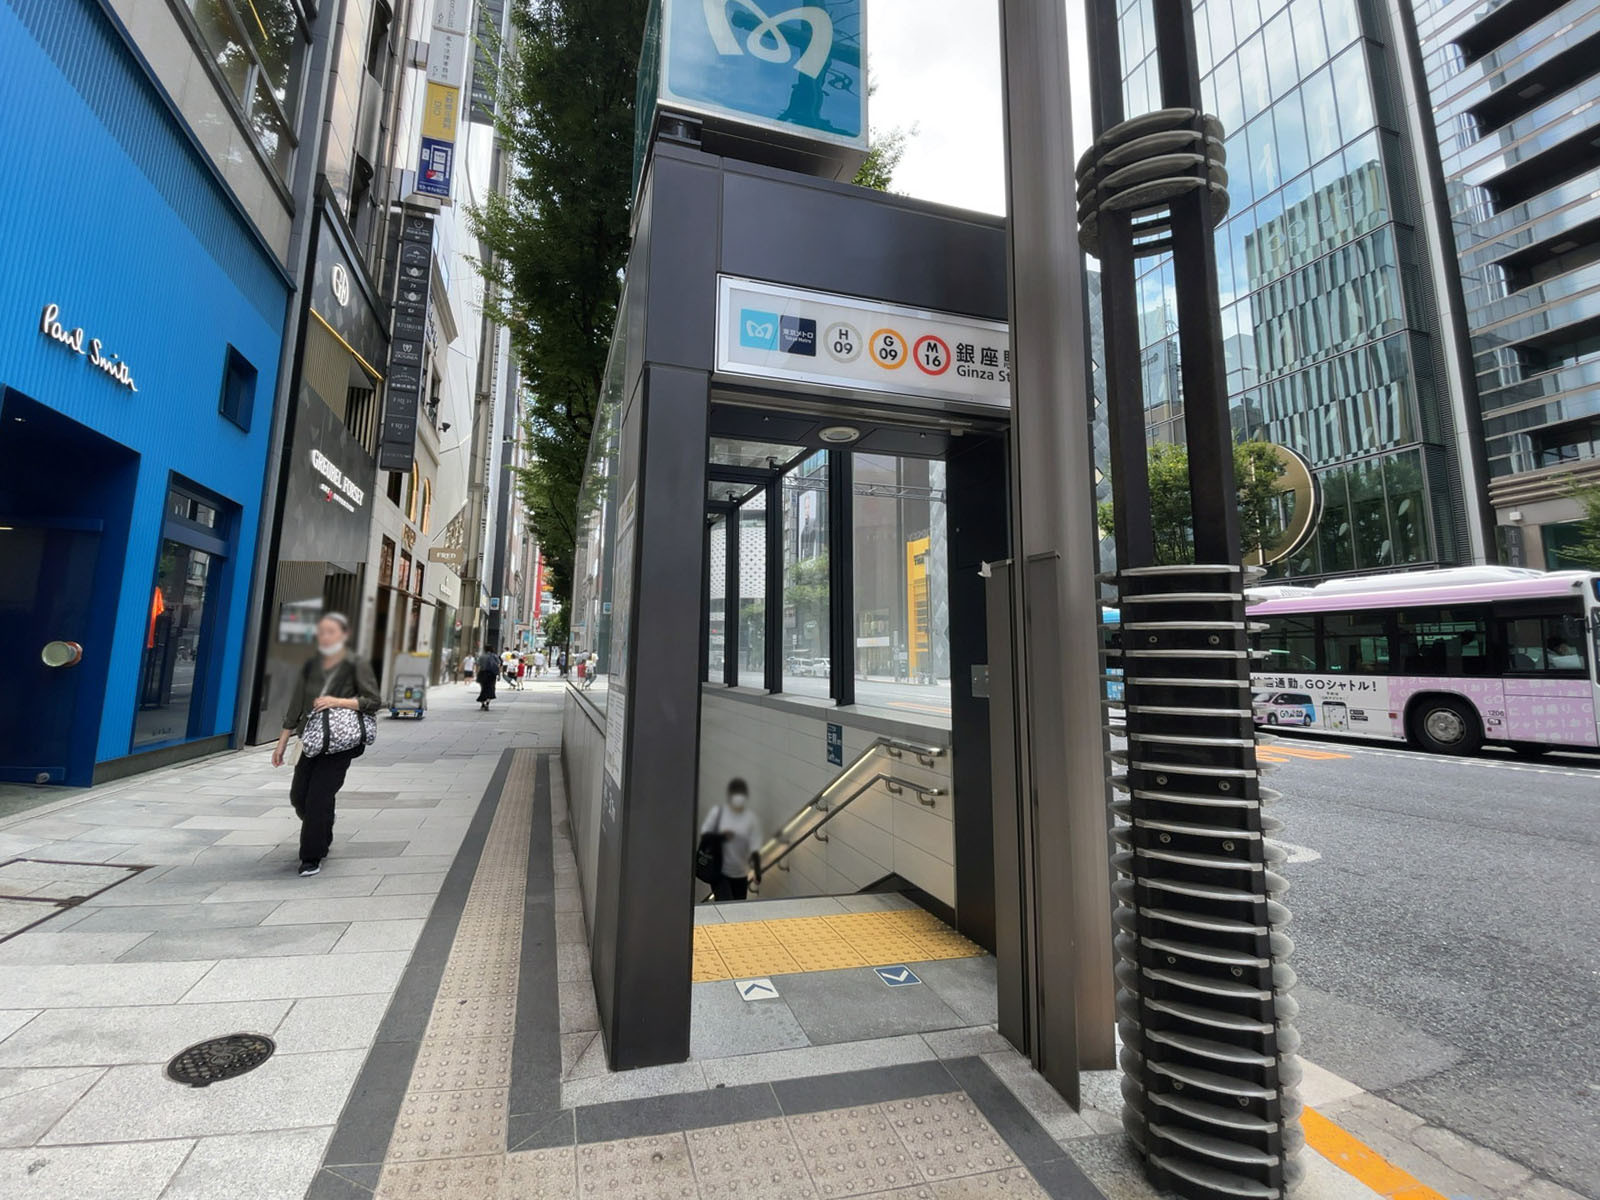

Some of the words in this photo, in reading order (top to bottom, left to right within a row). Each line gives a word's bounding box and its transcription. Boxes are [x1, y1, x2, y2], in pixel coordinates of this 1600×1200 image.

[782, 328, 814, 339] 東京メトロ
[839, 328, 849, 341] H
[42, 303, 86, 355] Paul
[90, 338, 139, 392] Smith
[833, 341, 853, 355] 09
[883, 336, 894, 348] G
[926, 342, 938, 354] M
[879, 348, 898, 361] 09
[924, 354, 942, 367] 16
[956, 365, 994, 381] Ginza
